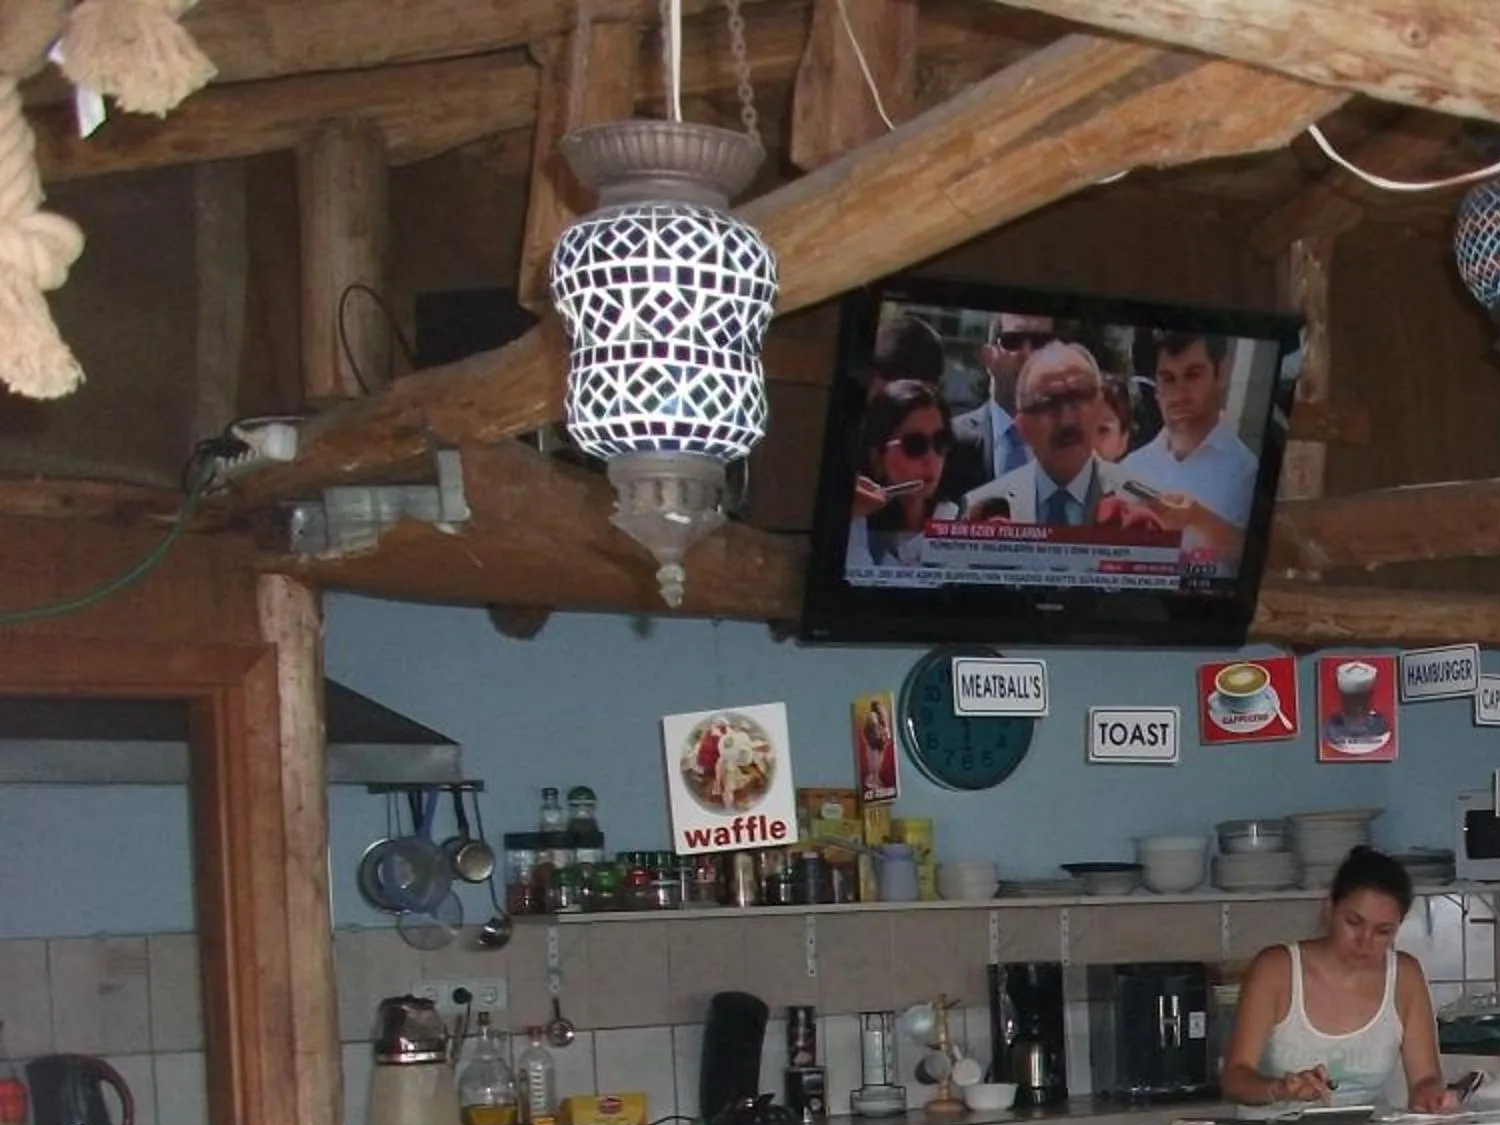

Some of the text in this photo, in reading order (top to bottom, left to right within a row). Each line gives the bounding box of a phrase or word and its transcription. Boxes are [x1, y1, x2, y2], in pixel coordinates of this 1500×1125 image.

[1407, 659, 1473, 686] HAMBURGER
[961, 673, 1041, 699] MEATBALL'S
[1098, 722, 1169, 746] TOAST
[684, 815, 786, 848] waffle
